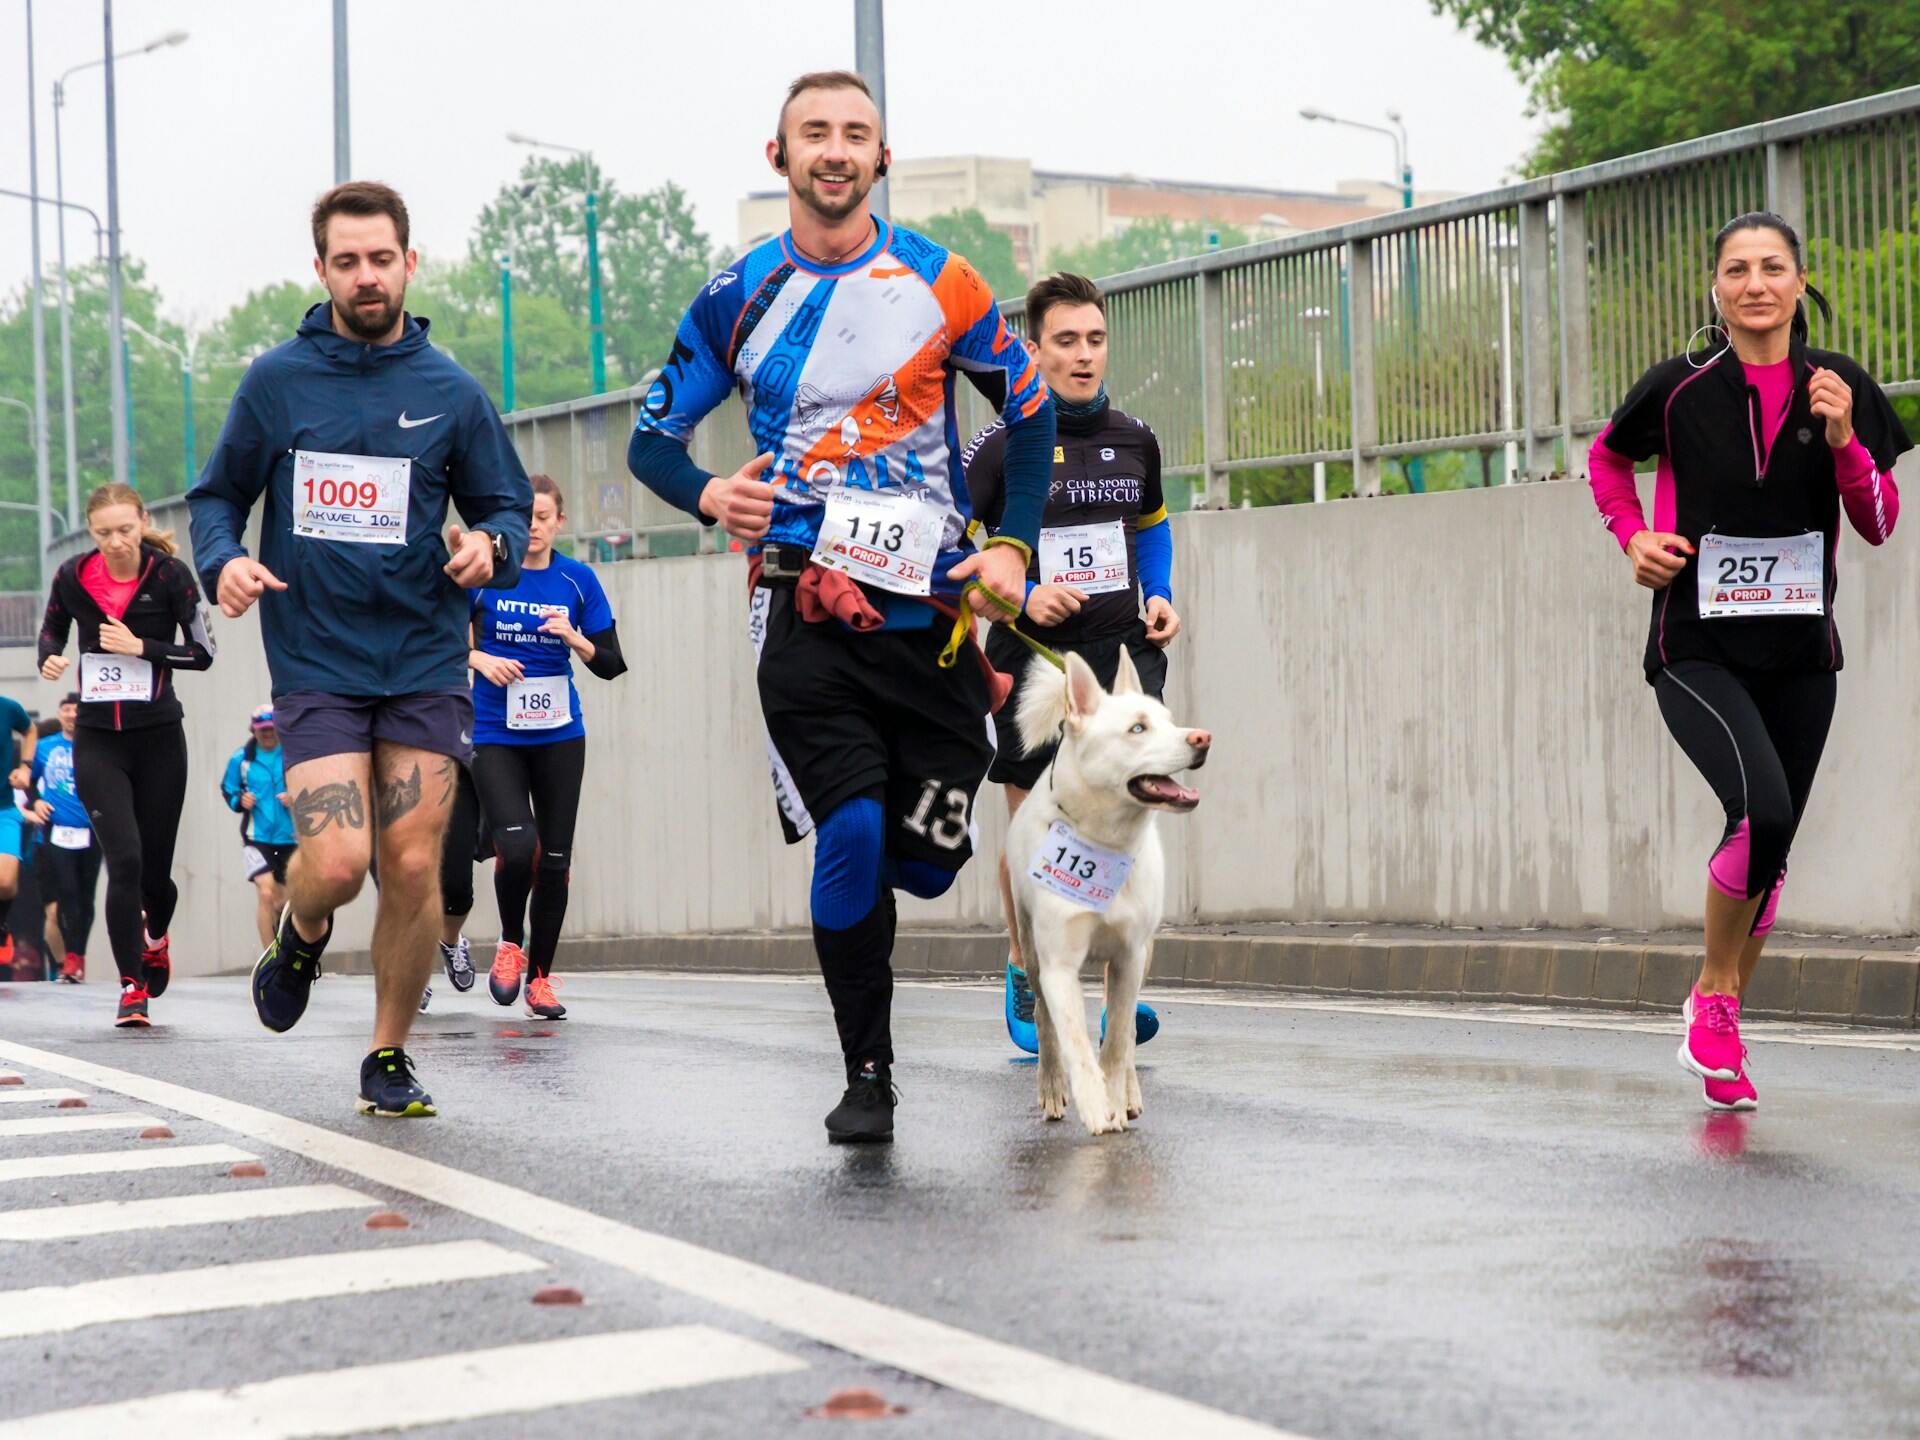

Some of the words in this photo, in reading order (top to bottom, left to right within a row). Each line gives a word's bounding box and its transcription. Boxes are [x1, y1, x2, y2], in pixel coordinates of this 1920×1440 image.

[783, 450, 925, 493] KOALA
[1066, 479, 1096, 490] CLUB
[303, 478, 378, 509] 1009
[1066, 487, 1140, 503] TIBISCUS
[306, 510, 363, 524] AKWEL
[370, 514, 389, 527] 10
[846, 516, 905, 552] 113
[851, 548, 887, 568] PROFI
[897, 562, 914, 580] 21
[1063, 546, 1094, 569] 15
[1067, 571, 1095, 581] PROFI
[1104, 567, 1117, 578] 21
[1718, 556, 1779, 584] 257
[1733, 589, 1769, 601] PROFI
[1784, 588, 1804, 600] 21
[496, 598, 528, 614] NTT
[496, 620, 523, 632] Run@
[496, 631, 512, 641] NTT
[514, 633, 537, 643] DATA
[98, 666, 122, 681] 33
[518, 692, 551, 710] 186
[526, 711, 545, 719] PROFI
[902, 779, 969, 850] 13
[1055, 846, 1097, 879] 113
[1054, 869, 1081, 888] PROFI
